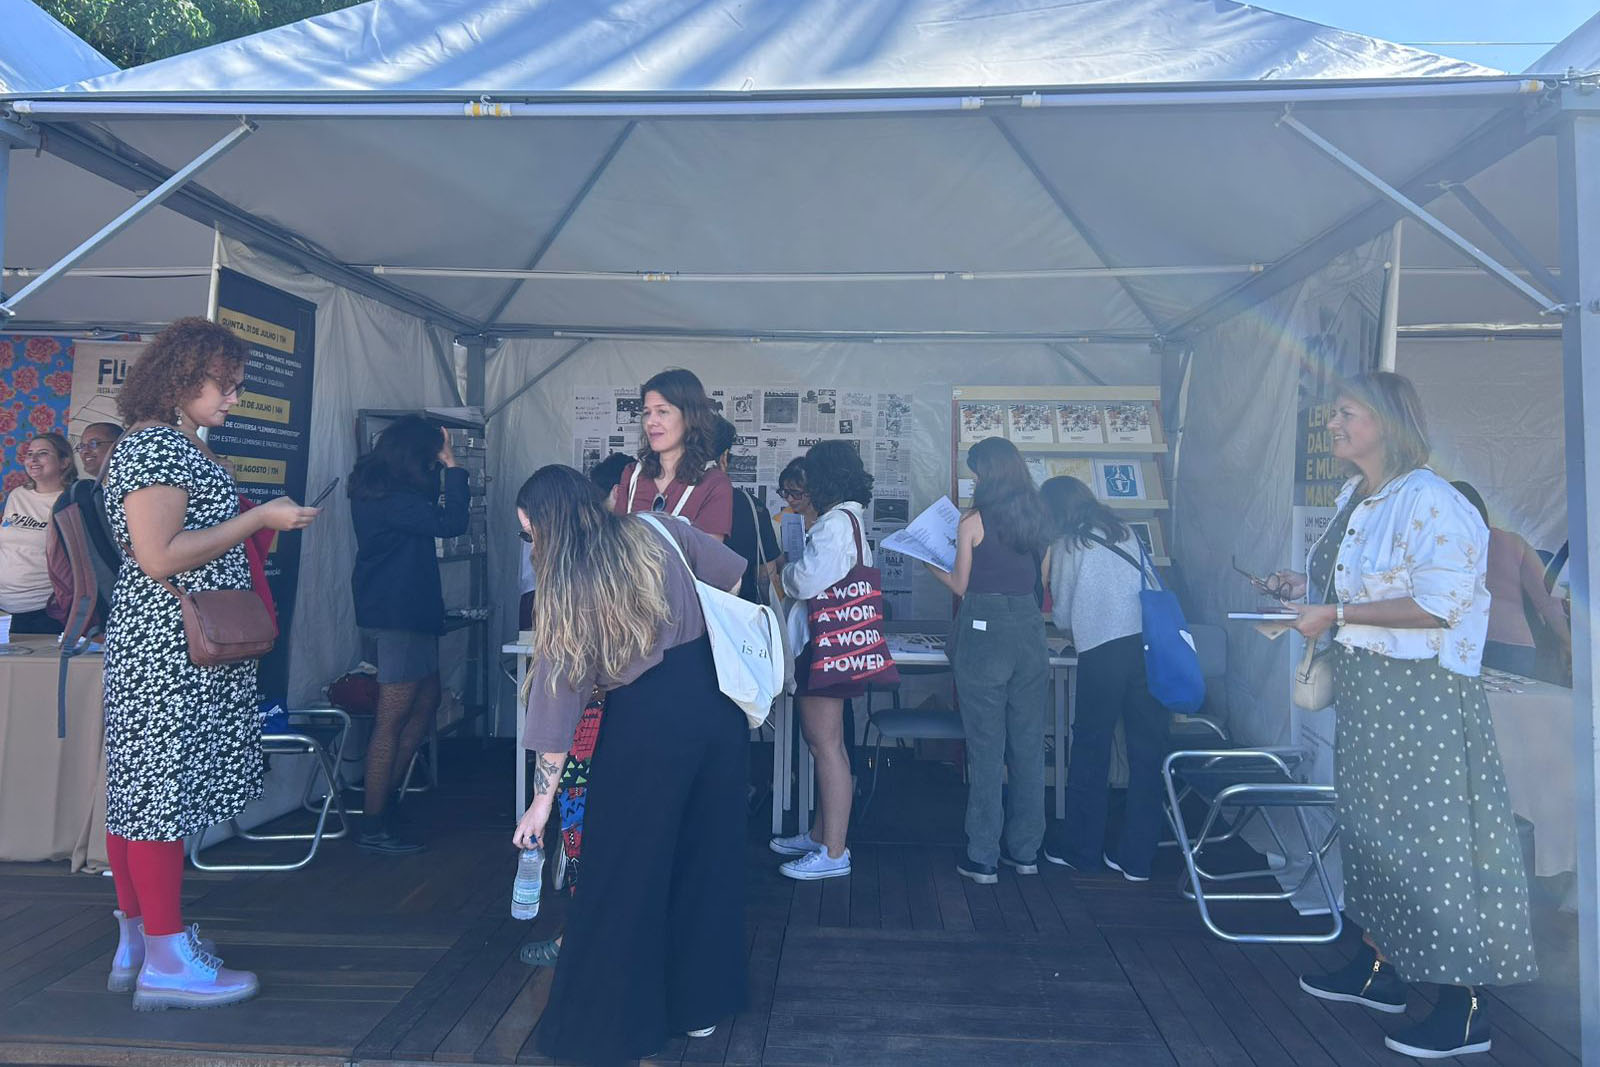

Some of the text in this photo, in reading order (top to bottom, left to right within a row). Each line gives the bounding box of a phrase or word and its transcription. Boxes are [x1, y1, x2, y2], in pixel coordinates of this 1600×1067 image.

[98, 358, 126, 384] FLi
[247, 401, 255, 410] DE
[256, 402, 272, 412] JULHO
[244, 464, 266, 474] AGOSTO
[832, 580, 873, 600] WORD
[818, 605, 877, 623] A WORD
[819, 629, 880, 647] A WORD
[742, 640, 753, 655] is
[823, 654, 884, 672] POWER
